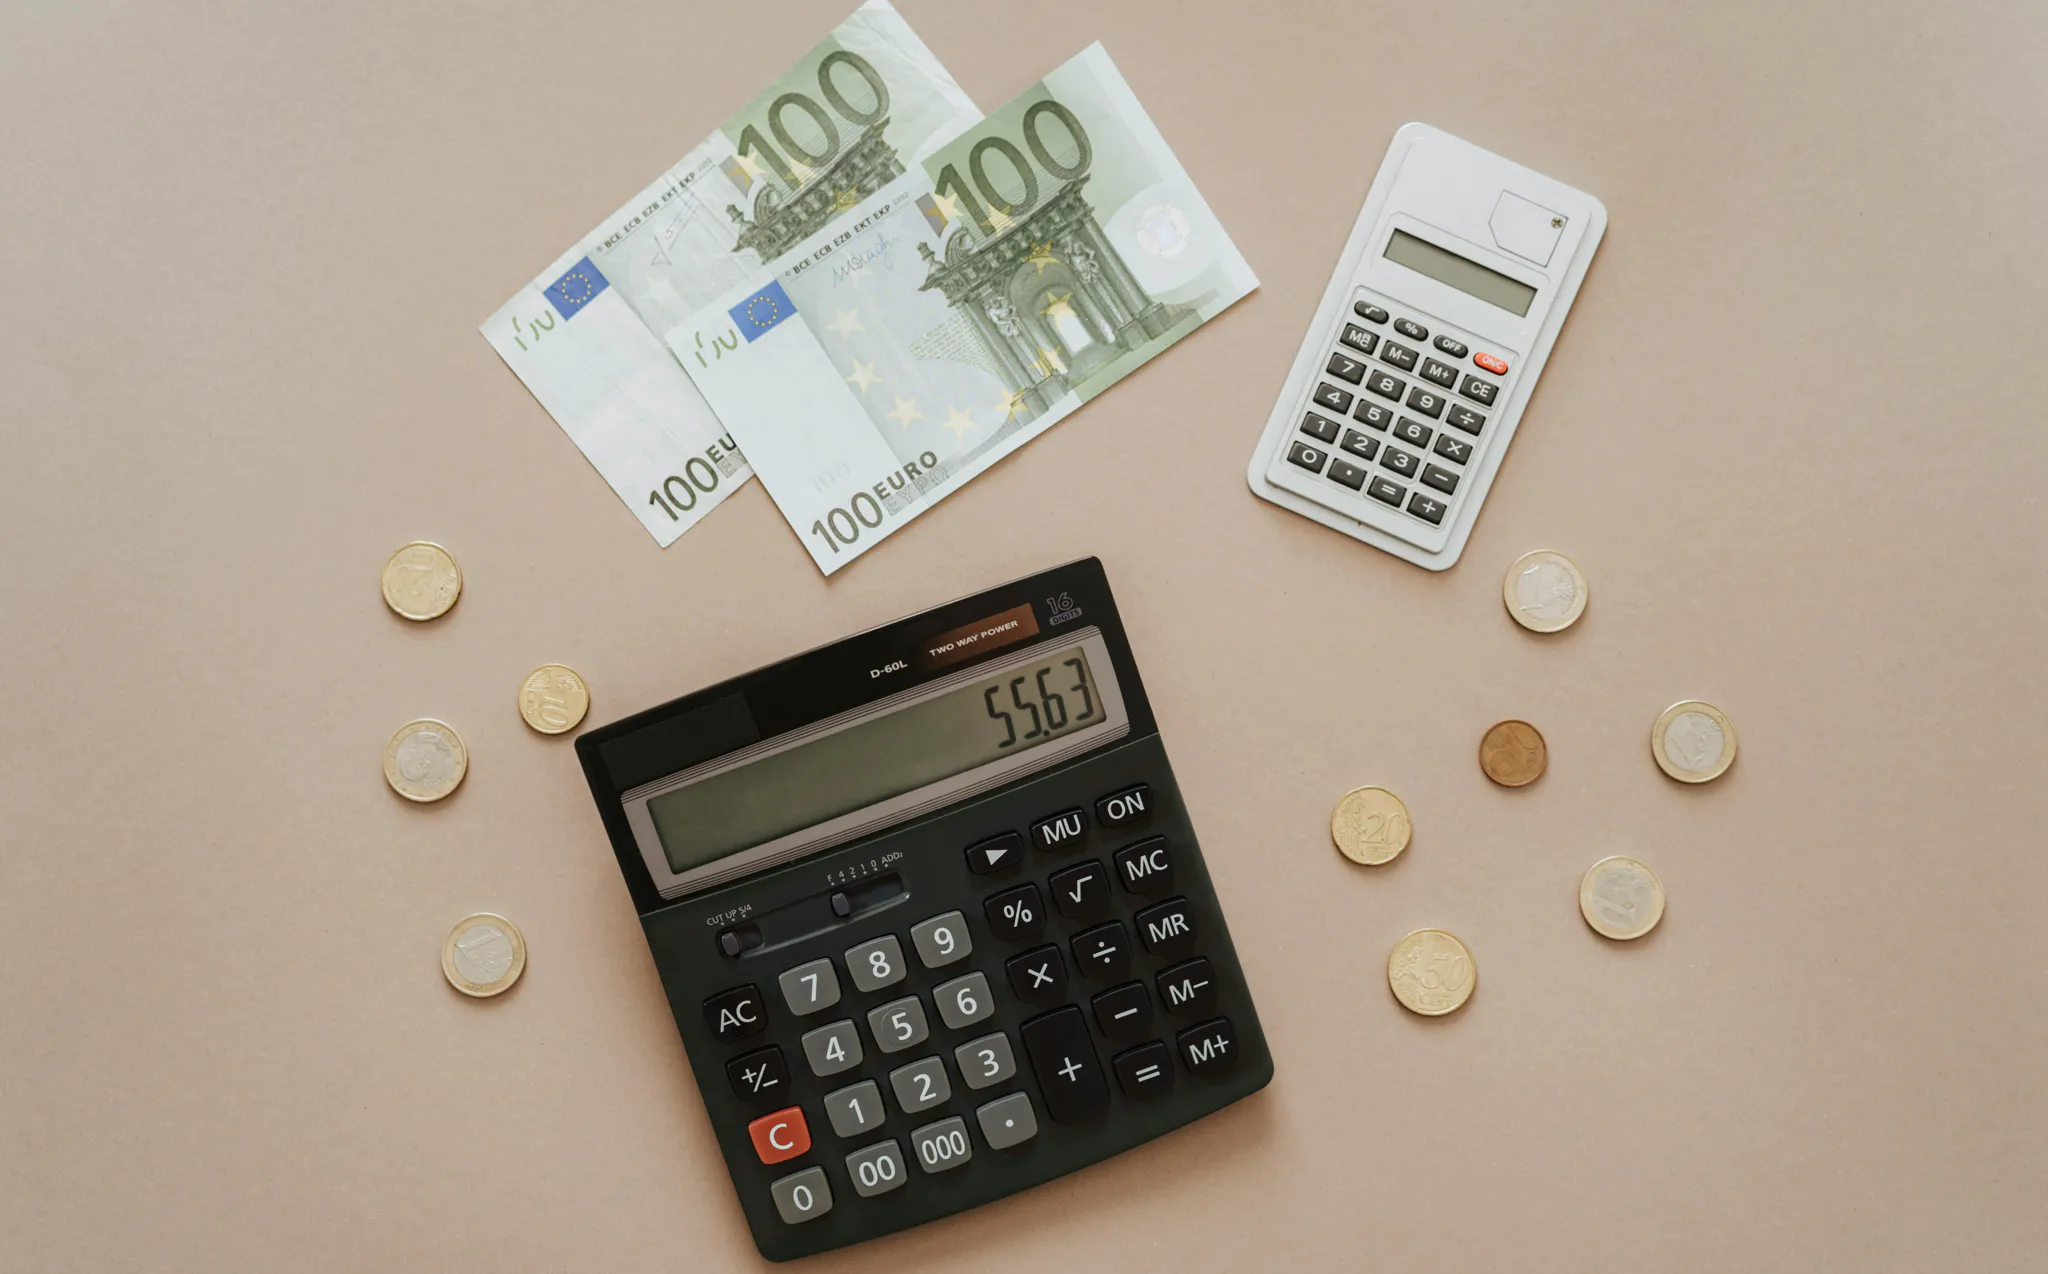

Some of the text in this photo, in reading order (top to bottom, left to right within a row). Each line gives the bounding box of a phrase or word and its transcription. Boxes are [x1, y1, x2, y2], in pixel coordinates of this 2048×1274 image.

[737, 50, 890, 191] 100
[935, 100, 1092, 238] 100
[604, 232, 623, 249] BCE
[623, 216, 641, 233] ECB
[642, 202, 660, 218] EZB
[793, 258, 812, 274] BCE
[813, 245, 832, 260] ECB
[833, 231, 852, 247] EZB
[854, 218, 872, 233] EKT
[1442, 339, 1462, 352] OFF
[1343, 361, 1356, 373] 7
[1327, 392, 1340, 403] 4
[1380, 378, 1394, 392] 8
[1470, 382, 1491, 398] CE
[1367, 407, 1381, 421] 5
[1420, 395, 1434, 408] 9
[1318, 421, 1326, 433] 1
[1408, 425, 1420, 437] 6
[1303, 449, 1317, 463] 0
[1354, 437, 1369, 450] 2
[1395, 454, 1409, 467] 3
[649, 457, 719, 522] 100
[812, 451, 937, 553] 100 EURO
[1046, 592, 1074, 615] 16
[1052, 608, 1080, 624] DIGITS
[929, 620, 1019, 657] TWO WAY POWER
[870, 660, 908, 679] D-60L
[1107, 791, 1145, 820] ON
[1041, 813, 1082, 845] MU
[827, 874, 833, 883] F
[839, 870, 845, 879] 4
[849, 867, 855, 875] 2
[1125, 849, 1168, 881] MC
[706, 904, 752, 926] CUT UP 5/4
[1148, 913, 1190, 943] MR
[933, 927, 955, 955] 9
[868, 950, 891, 978] 8
[800, 973, 818, 1002] 7
[957, 987, 978, 1015] 6
[718, 1000, 758, 1033] AC
[891, 1011, 913, 1041] 5
[826, 1036, 846, 1062] 4
[977, 1049, 1000, 1077] 3
[913, 1073, 937, 1102] 2
[848, 1098, 865, 1124] 1
[769, 1123, 794, 1150] C
[921, 1130, 966, 1165] 000
[858, 1155, 896, 1187] 00
[792, 1185, 814, 1211] 0
